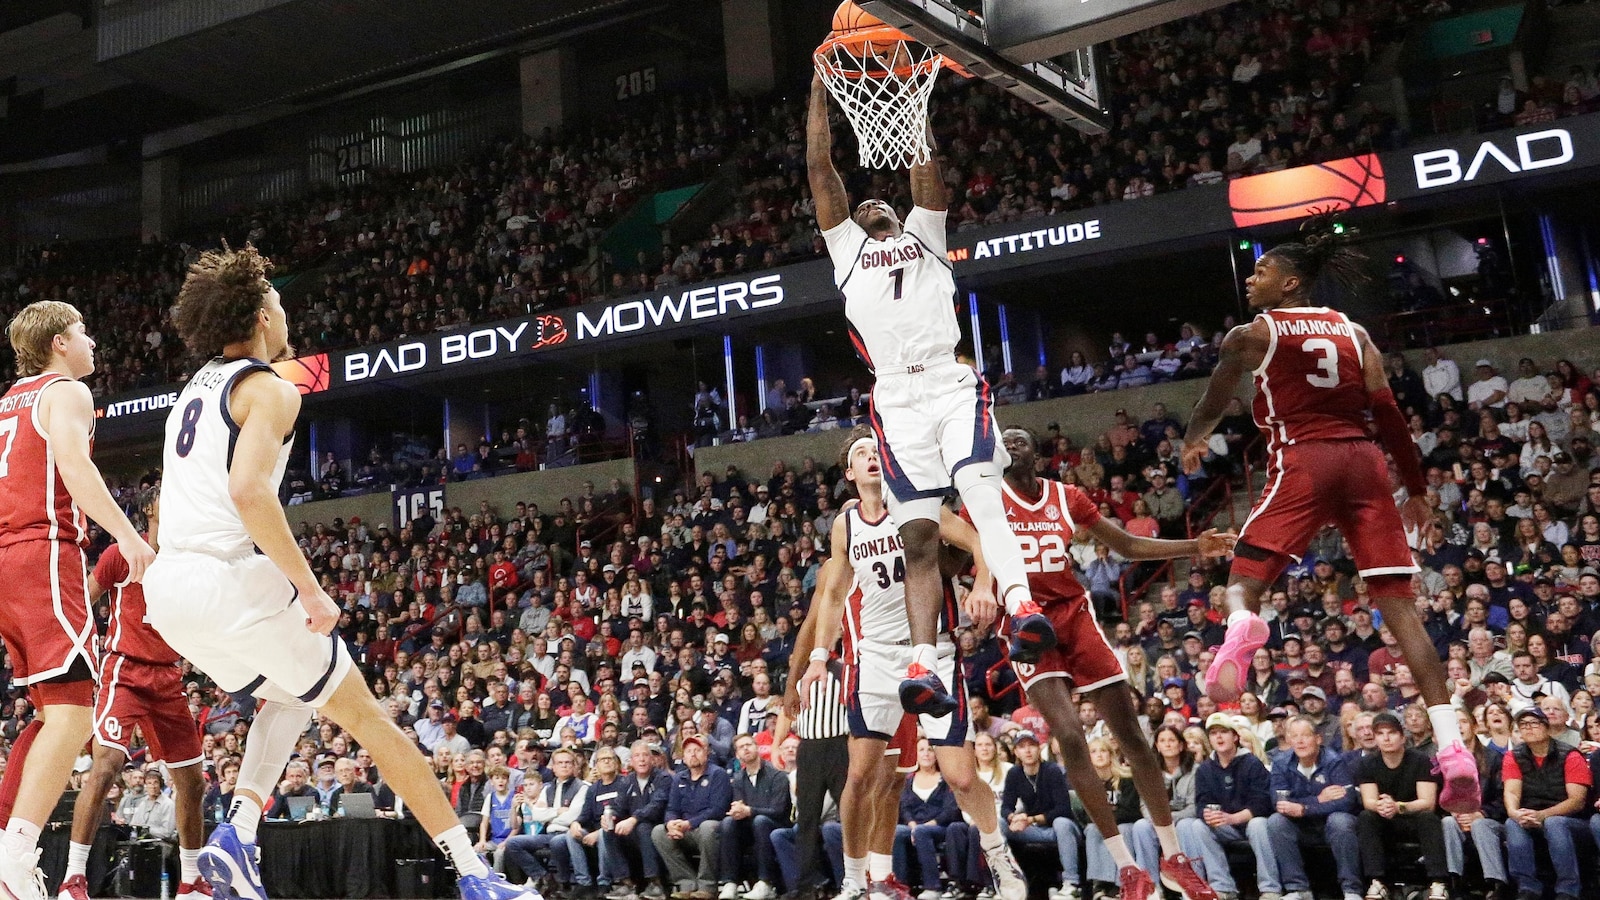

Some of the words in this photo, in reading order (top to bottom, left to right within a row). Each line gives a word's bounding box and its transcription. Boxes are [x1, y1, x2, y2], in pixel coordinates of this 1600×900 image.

[616, 68, 656, 100] 205
[1413, 128, 1574, 189] BAD
[974, 219, 1101, 260] ATTITUDE
[888, 267, 904, 301] 1
[345, 342, 427, 382] BAD
[441, 321, 529, 364] BOY
[576, 274, 785, 340] MOWERS
[1275, 319, 1350, 337] NWANKWO
[906, 363, 925, 375] ZAGS
[1301, 338, 1340, 389] 3
[106, 392, 178, 418] ATTITUDE
[175, 397, 204, 459] 8
[1014, 534, 1066, 573] 22
[872, 555, 906, 590] 34
